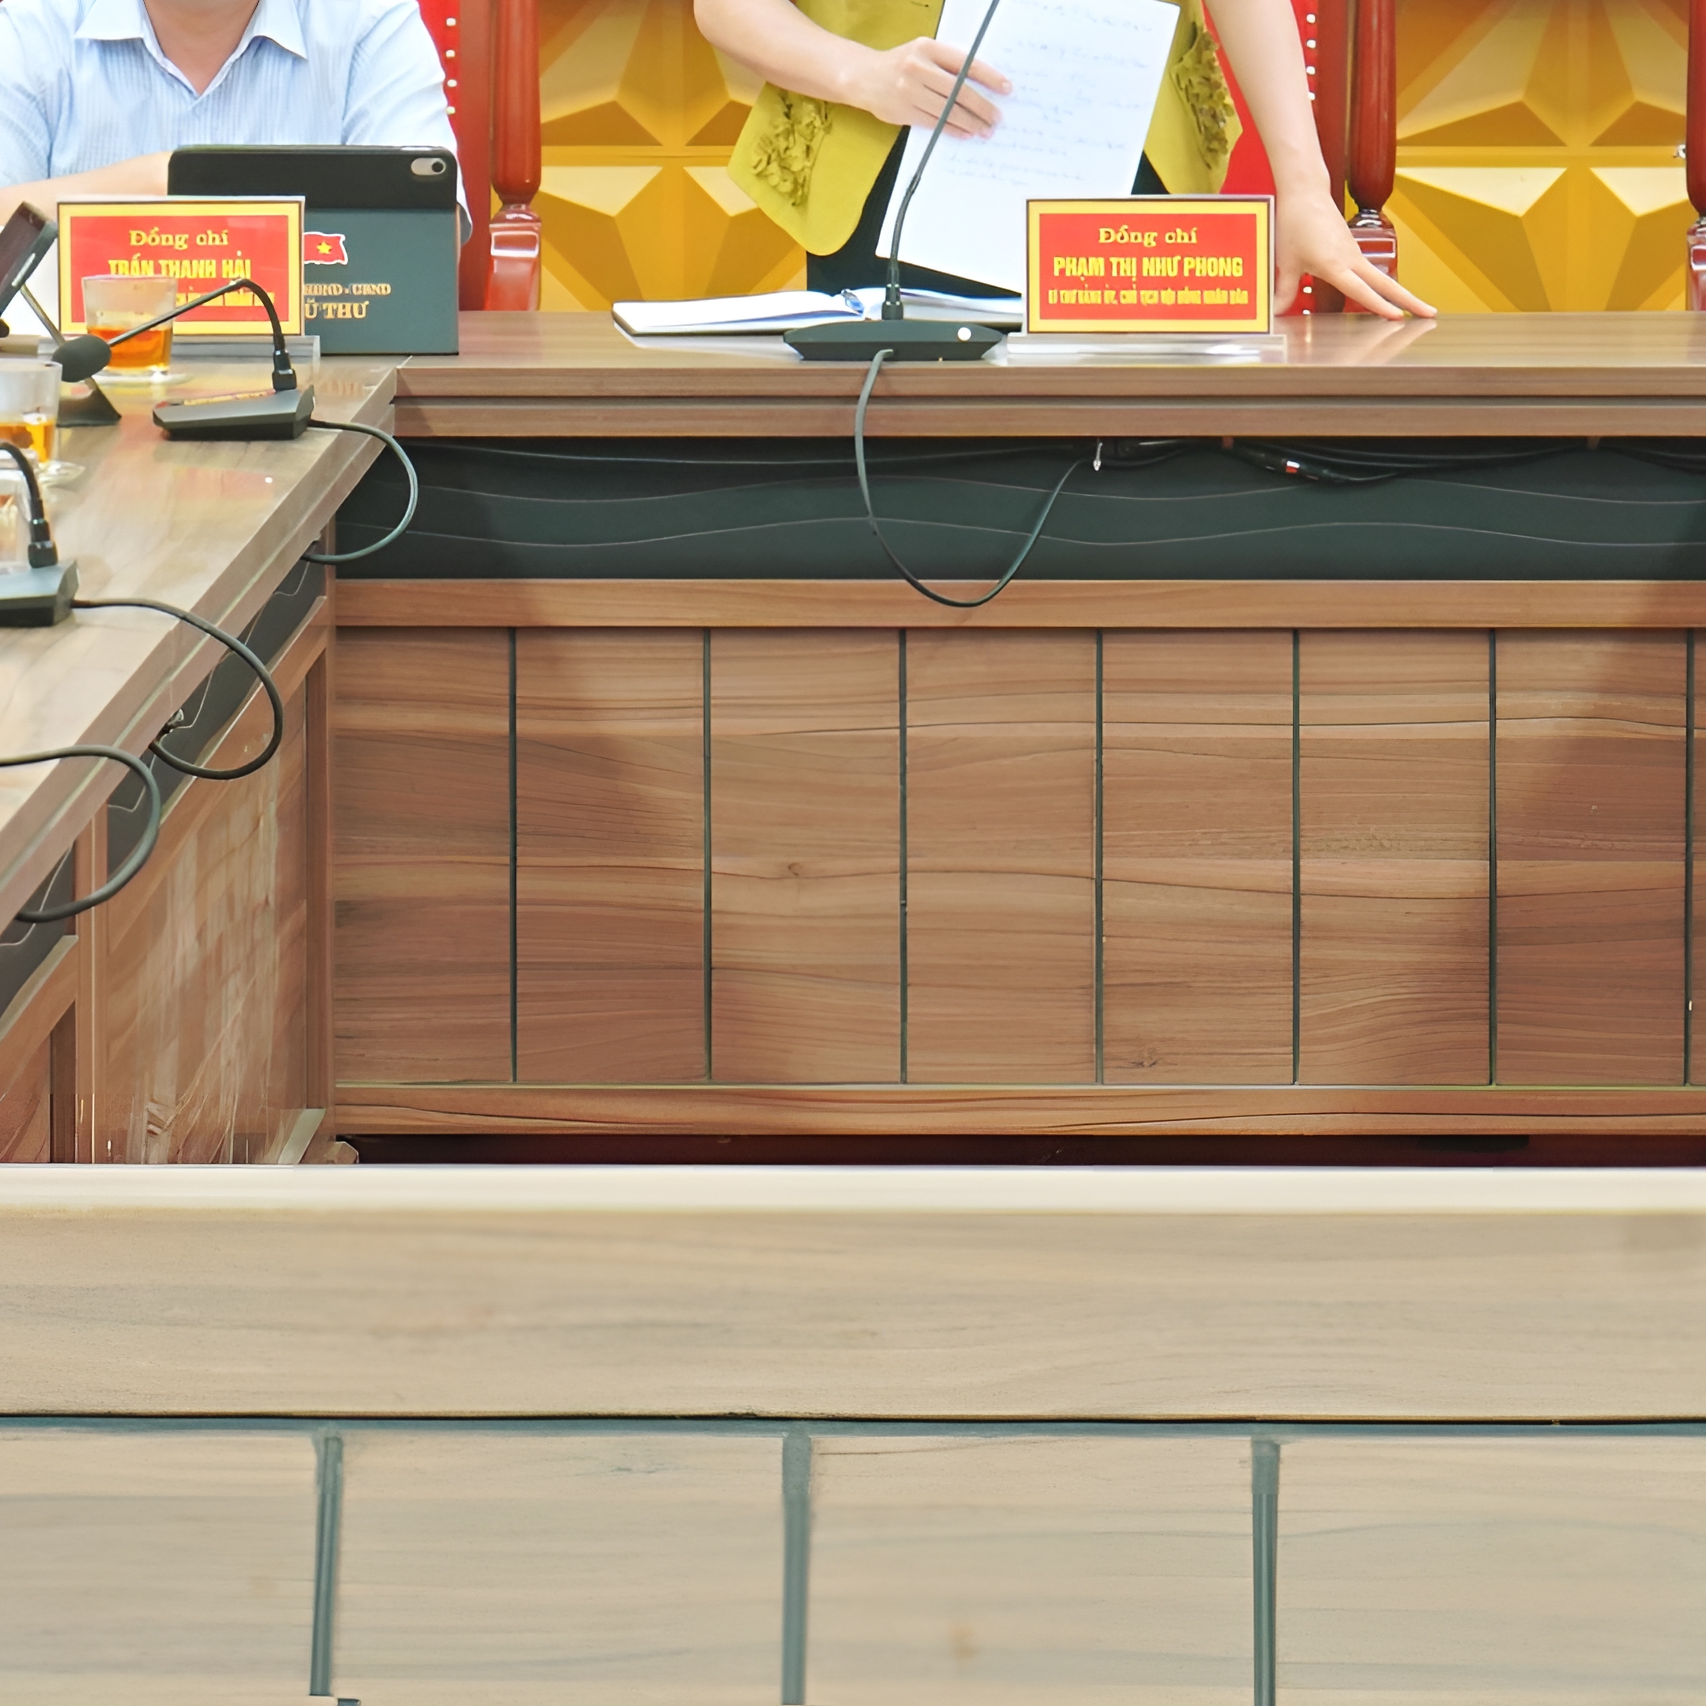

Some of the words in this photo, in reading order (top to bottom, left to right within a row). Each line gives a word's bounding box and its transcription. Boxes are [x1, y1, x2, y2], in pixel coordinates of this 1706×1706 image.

[1165, 227, 1198, 244] chí
[159, 258, 217, 279] THANH
[1053, 256, 1105, 282] PHẠM
[1109, 256, 1137, 282] THỊ
[1142, 255, 1182, 277] NHƯ
[1183, 256, 1243, 278] PHONG
[304, 297, 318, 319] Ũ
[322, 300, 370, 319] THƯ
